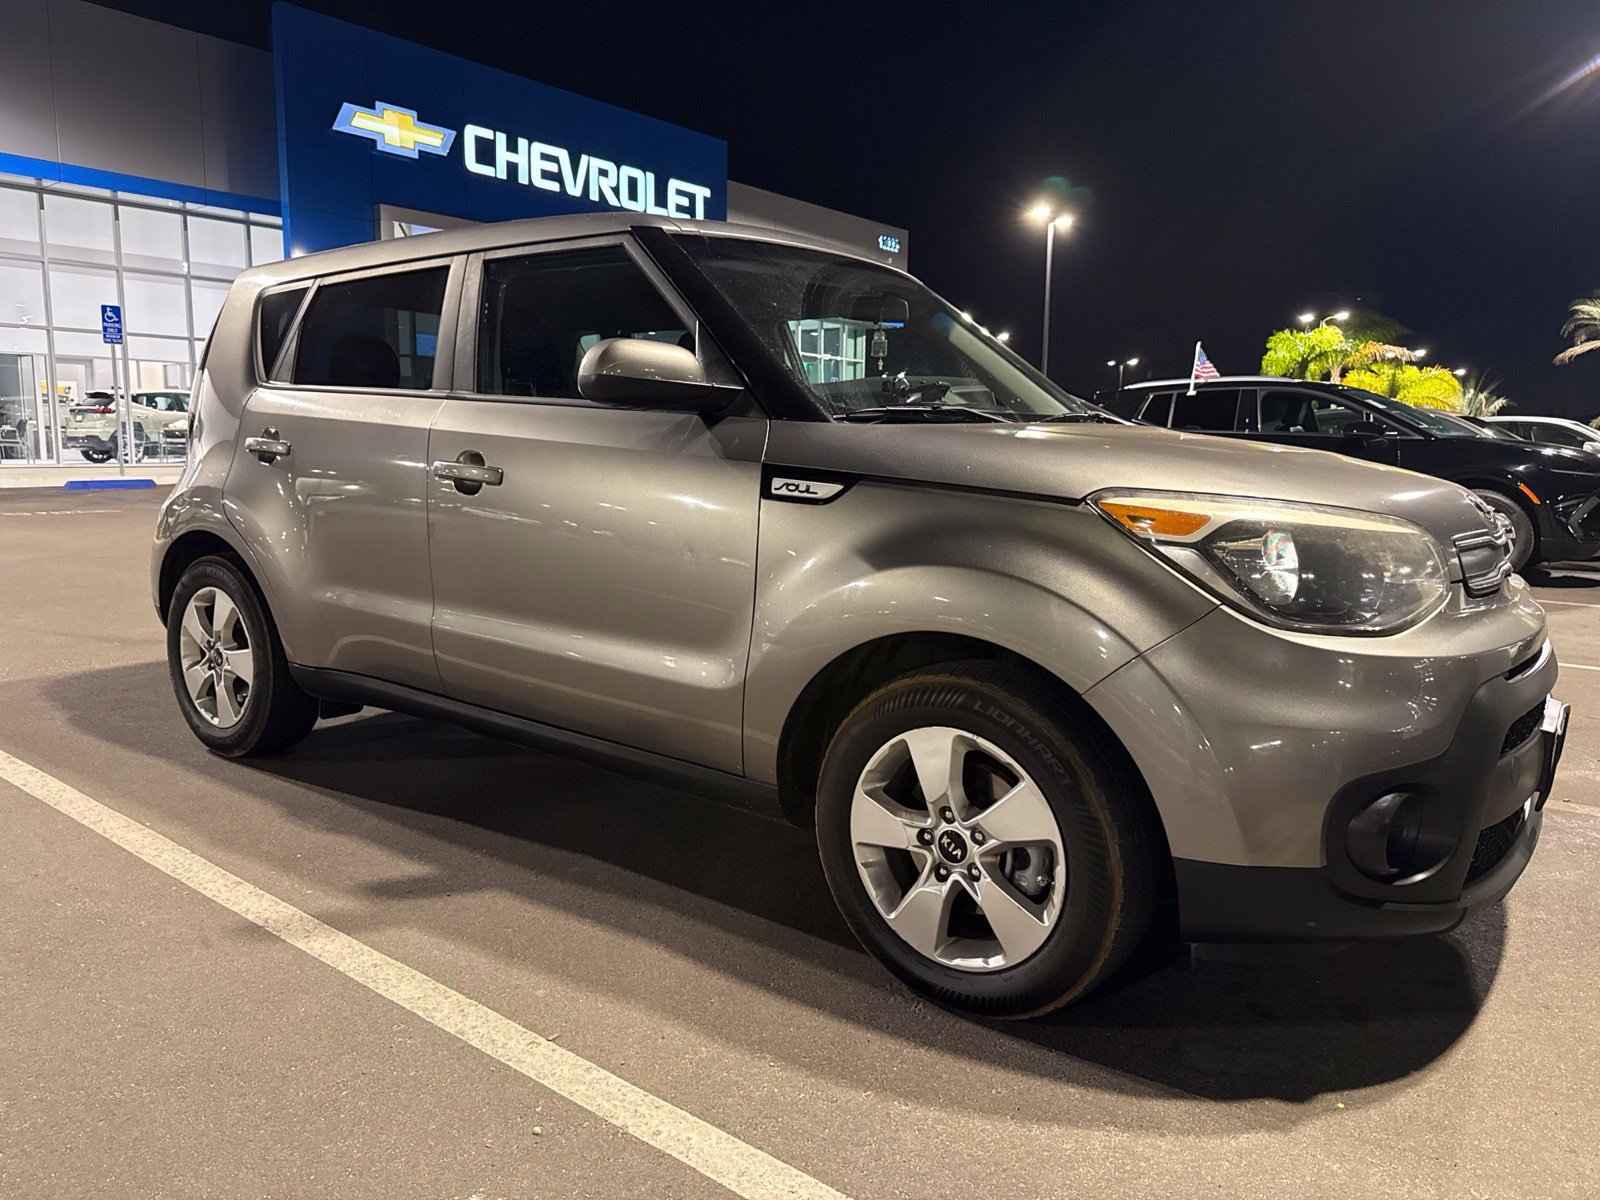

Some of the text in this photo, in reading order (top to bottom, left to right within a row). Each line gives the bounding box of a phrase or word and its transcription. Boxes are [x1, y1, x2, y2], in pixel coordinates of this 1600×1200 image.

[463, 124, 711, 219] CHEVROLET
[974, 700, 1073, 786] LIONHART
[941, 834, 962, 860] KIA
